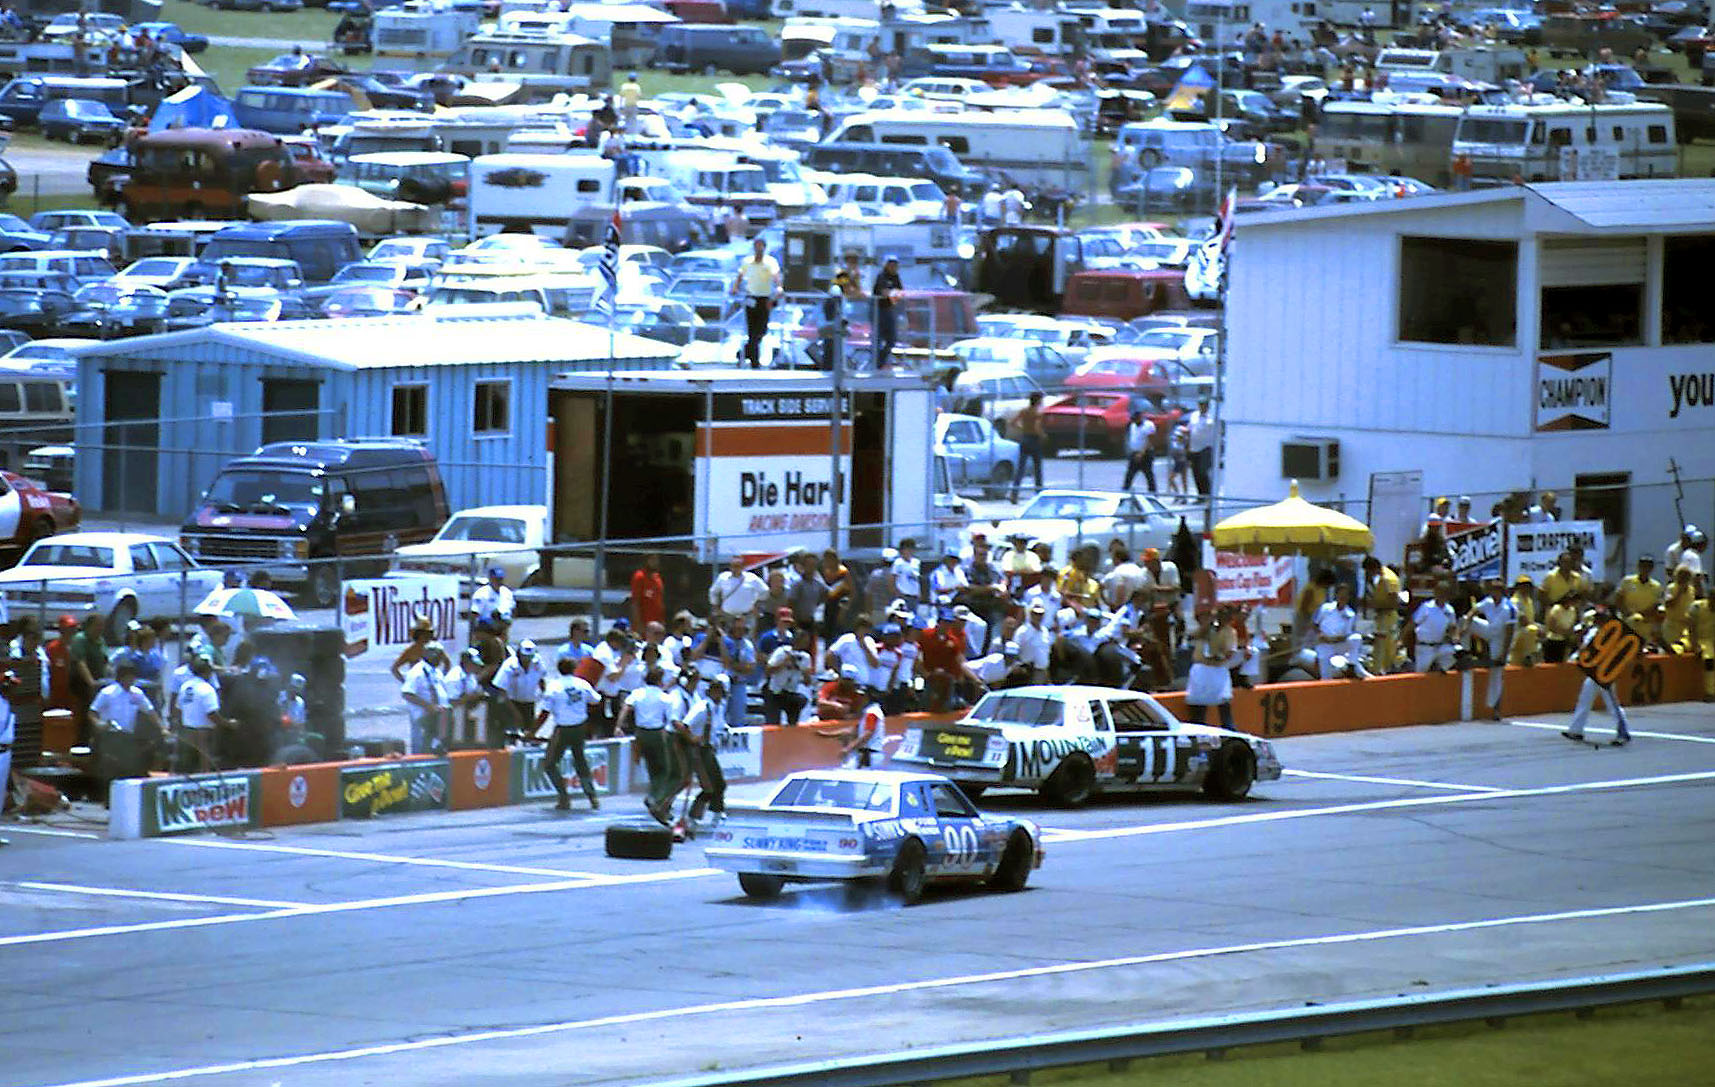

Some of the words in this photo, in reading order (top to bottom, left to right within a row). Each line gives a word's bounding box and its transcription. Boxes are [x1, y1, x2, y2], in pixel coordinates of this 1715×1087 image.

[742, 399, 776, 414] TRACK
[778, 398, 801, 414] SIDE
[803, 397, 849, 413] SERVE
[1540, 375, 1607, 408] CHAMPION
[1668, 373, 1715, 418] you
[740, 472, 778, 507] Die
[1580, 619, 1639, 684] 90
[1631, 664, 1662, 702] 20
[452, 702, 488, 742] 11
[1260, 691, 1289, 734] 19
[1135, 736, 1176, 783] 11
[943, 824, 978, 870] 90
